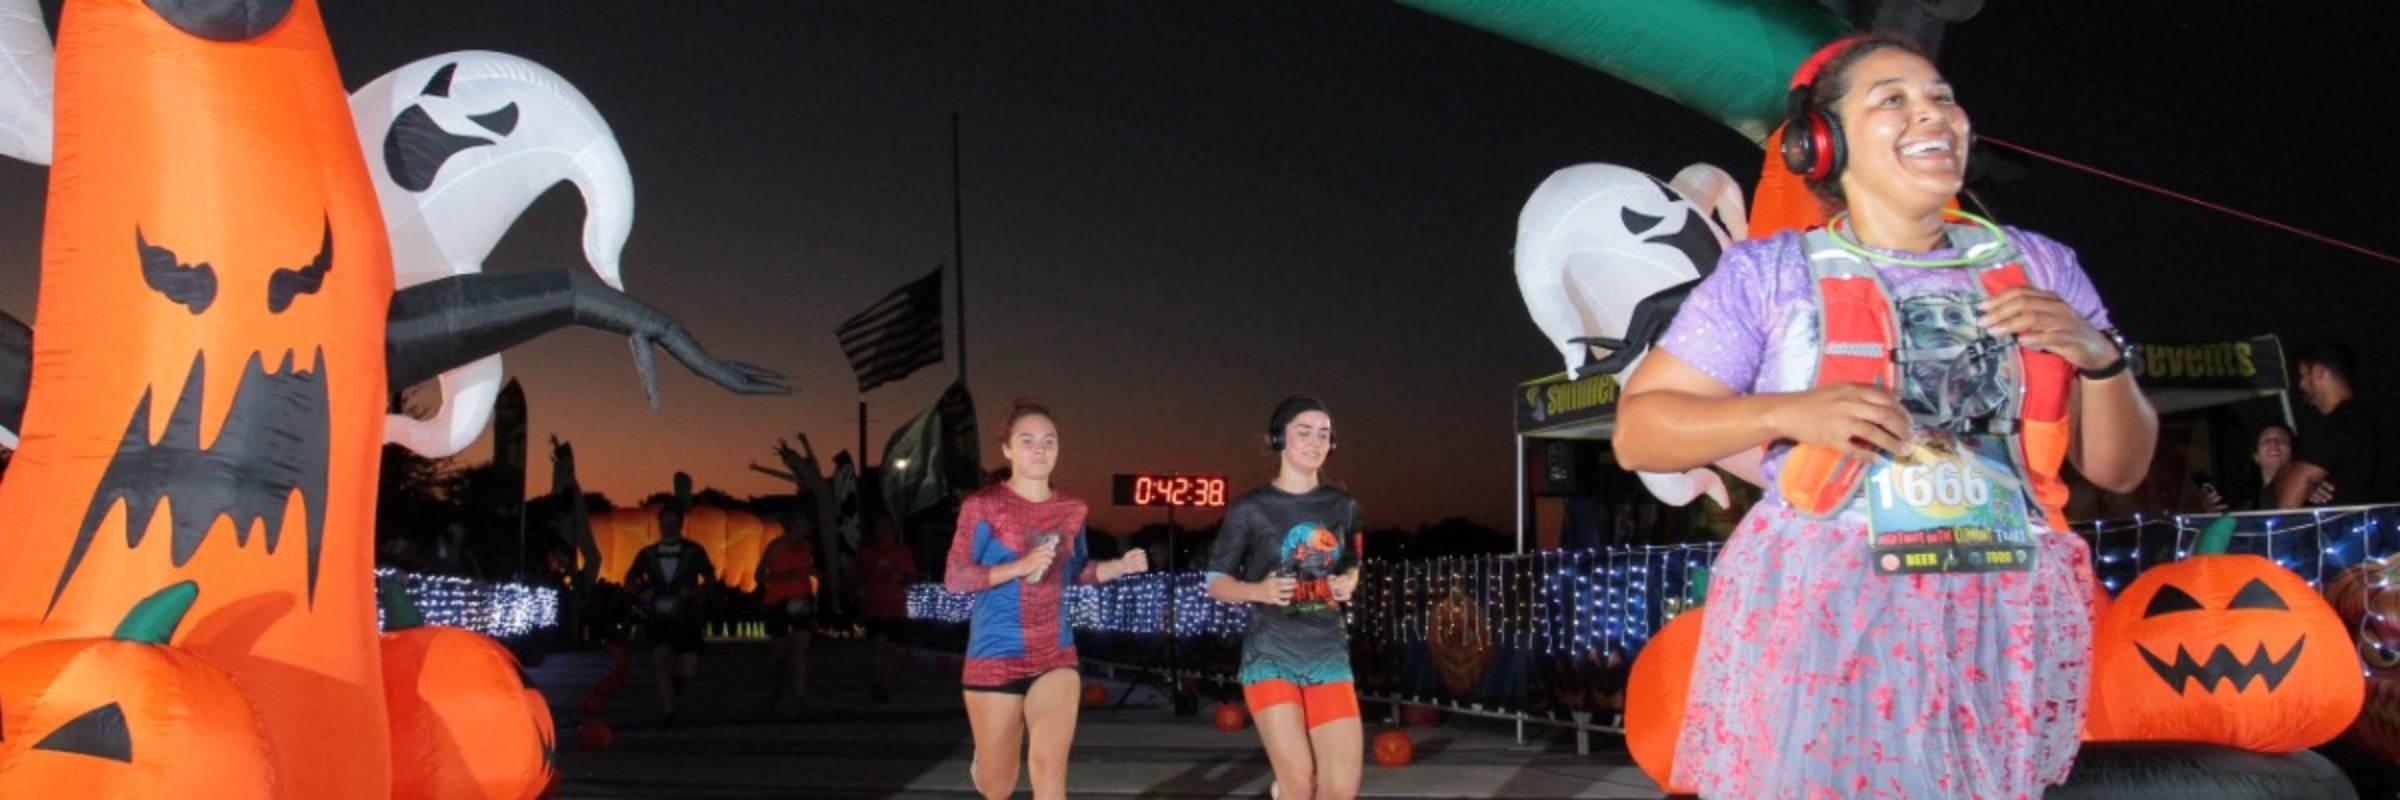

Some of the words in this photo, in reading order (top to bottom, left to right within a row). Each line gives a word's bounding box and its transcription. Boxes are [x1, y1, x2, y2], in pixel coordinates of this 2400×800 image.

[1871, 464, 1989, 509] 1666
[1905, 552, 1938, 567] BEER
[1985, 551, 2012, 565] FOOD
